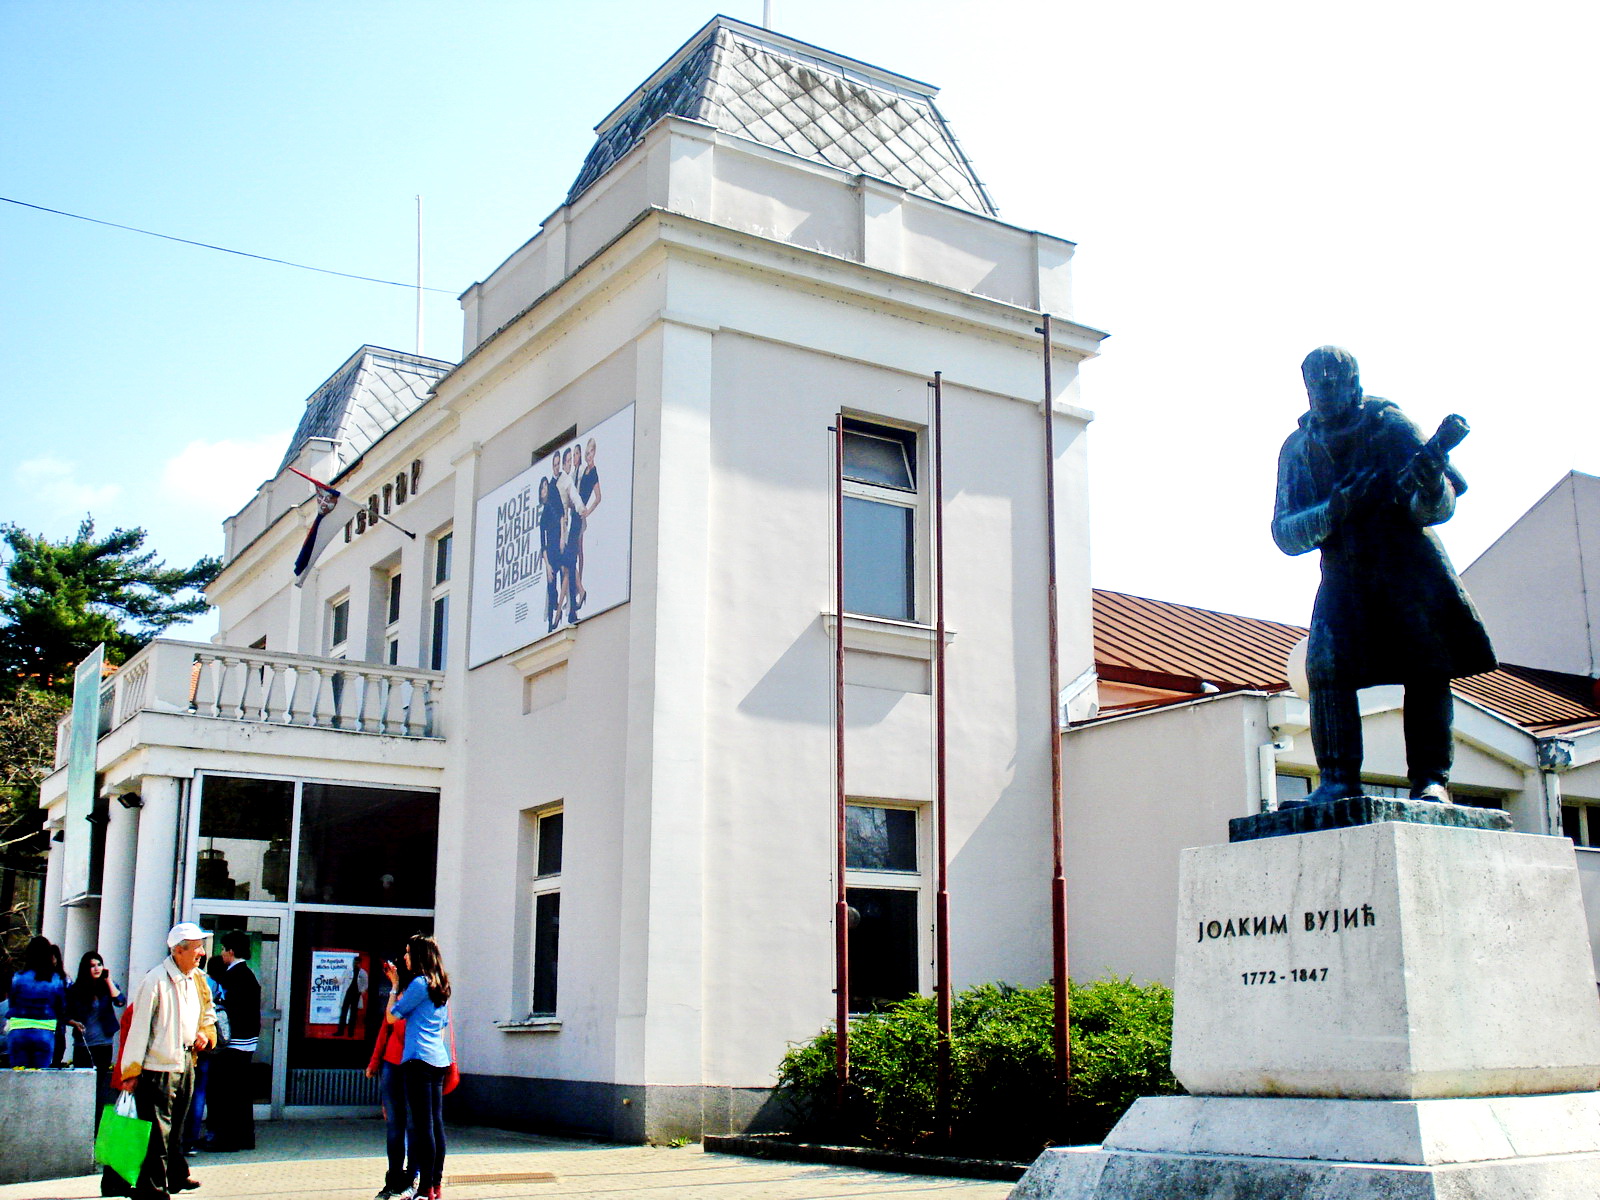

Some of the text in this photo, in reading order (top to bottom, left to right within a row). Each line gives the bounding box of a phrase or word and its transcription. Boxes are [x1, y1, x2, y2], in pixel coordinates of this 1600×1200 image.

[496, 504, 544, 549] БИВШЕ
[497, 488, 531, 527] МОЈЕ
[494, 549, 543, 594] БИВШИ
[495, 533, 530, 571] МОЈИ
[1197, 903, 1376, 943] ЈОАКИМ ВУЈИЋ
[314, 976, 333, 986] ONE
[1241, 970, 1276, 985] 1772
[1290, 968, 1329, 982] 1847
